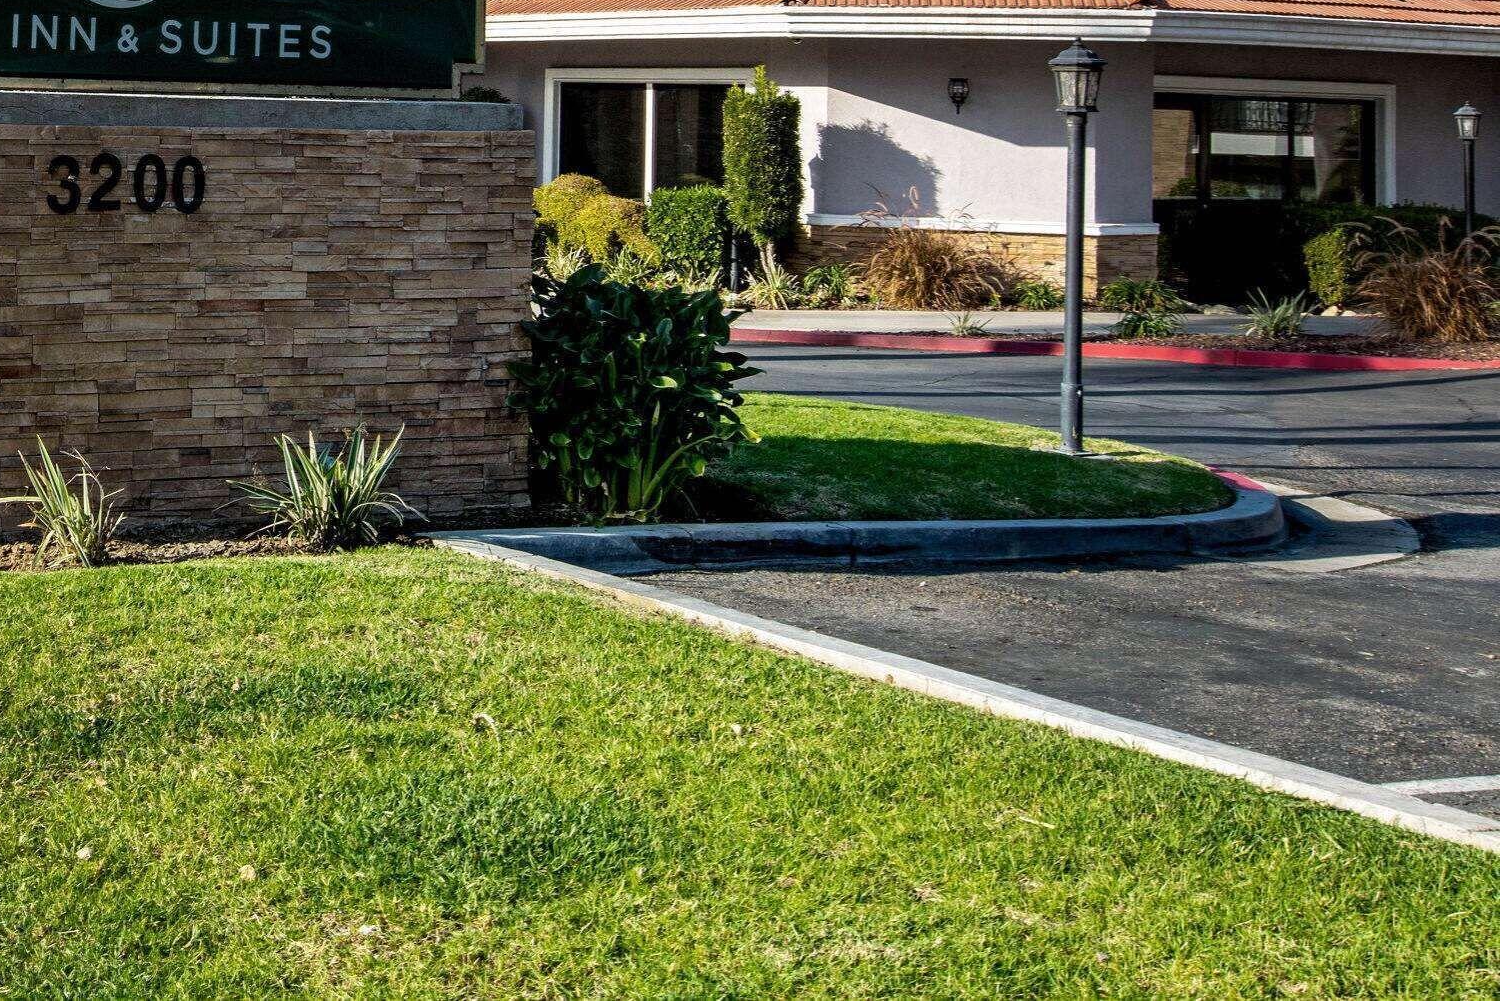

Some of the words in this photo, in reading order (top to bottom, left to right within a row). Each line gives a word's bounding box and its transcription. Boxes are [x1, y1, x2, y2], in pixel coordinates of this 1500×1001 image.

[11, 13, 97, 52] INN
[117, 24, 140, 54] &
[160, 19, 333, 59] SUITES
[47, 152, 206, 215] 3200
